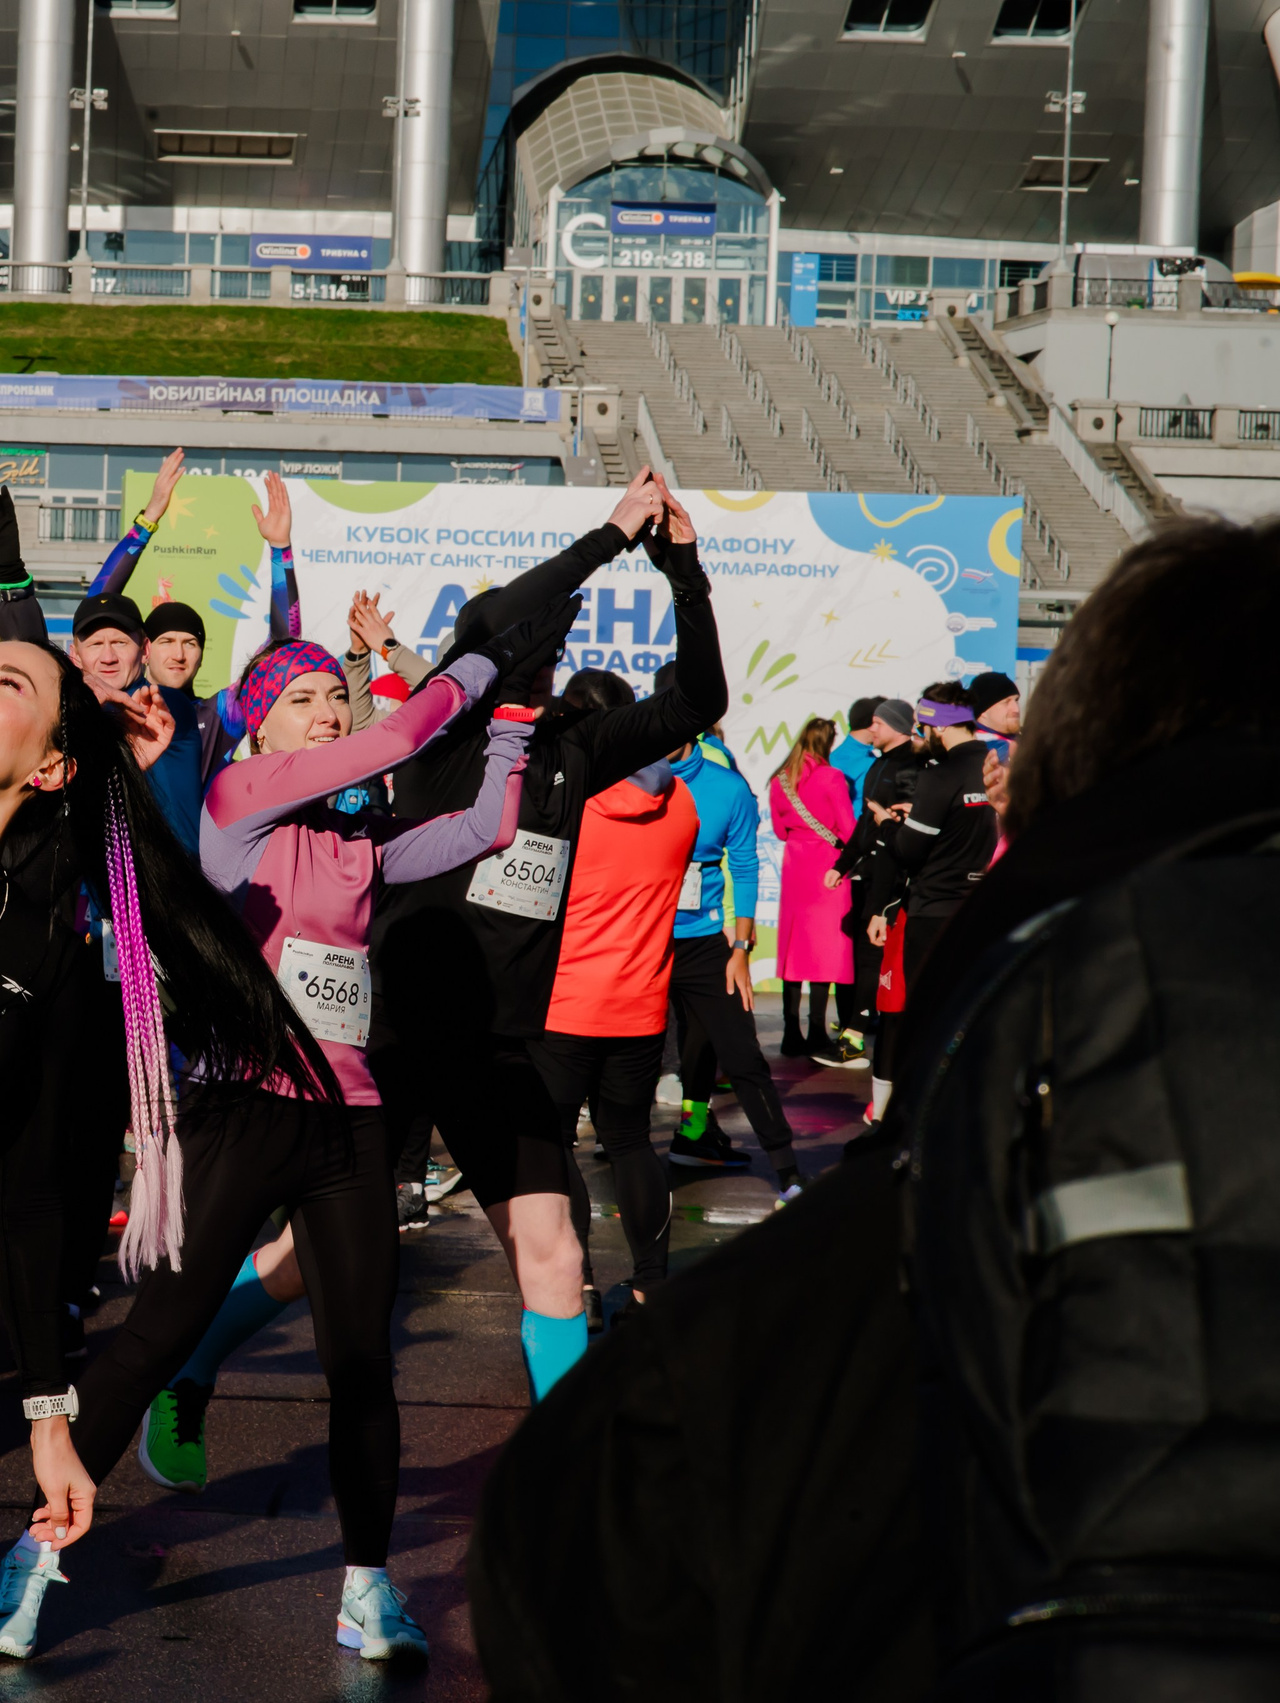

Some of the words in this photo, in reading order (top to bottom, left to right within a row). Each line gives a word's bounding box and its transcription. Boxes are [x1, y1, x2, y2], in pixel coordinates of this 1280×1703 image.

[321, 249, 359, 257] ТРИБУНА
[885, 289, 917, 305] VIP
[149, 382, 266, 403] ЮБИЛЕЙНАЯ
[271, 387, 381, 408] ПЛОЩАДКА
[347, 526, 430, 545] КУБОК
[436, 529, 535, 547] РОССИИ
[541, 532, 575, 548] ПО
[153, 545, 217, 555] PushkinRun
[301, 549, 426, 566] ЧЕМПИОНАТ
[524, 839, 554, 852] АРЕНА
[503, 858, 556, 887] 6504
[500, 877, 550, 895] КОНСТАНТИН
[324, 952, 355, 967] АРЕНА
[305, 975, 360, 1007] 6568
[316, 1001, 347, 1015] МАРИЯ
